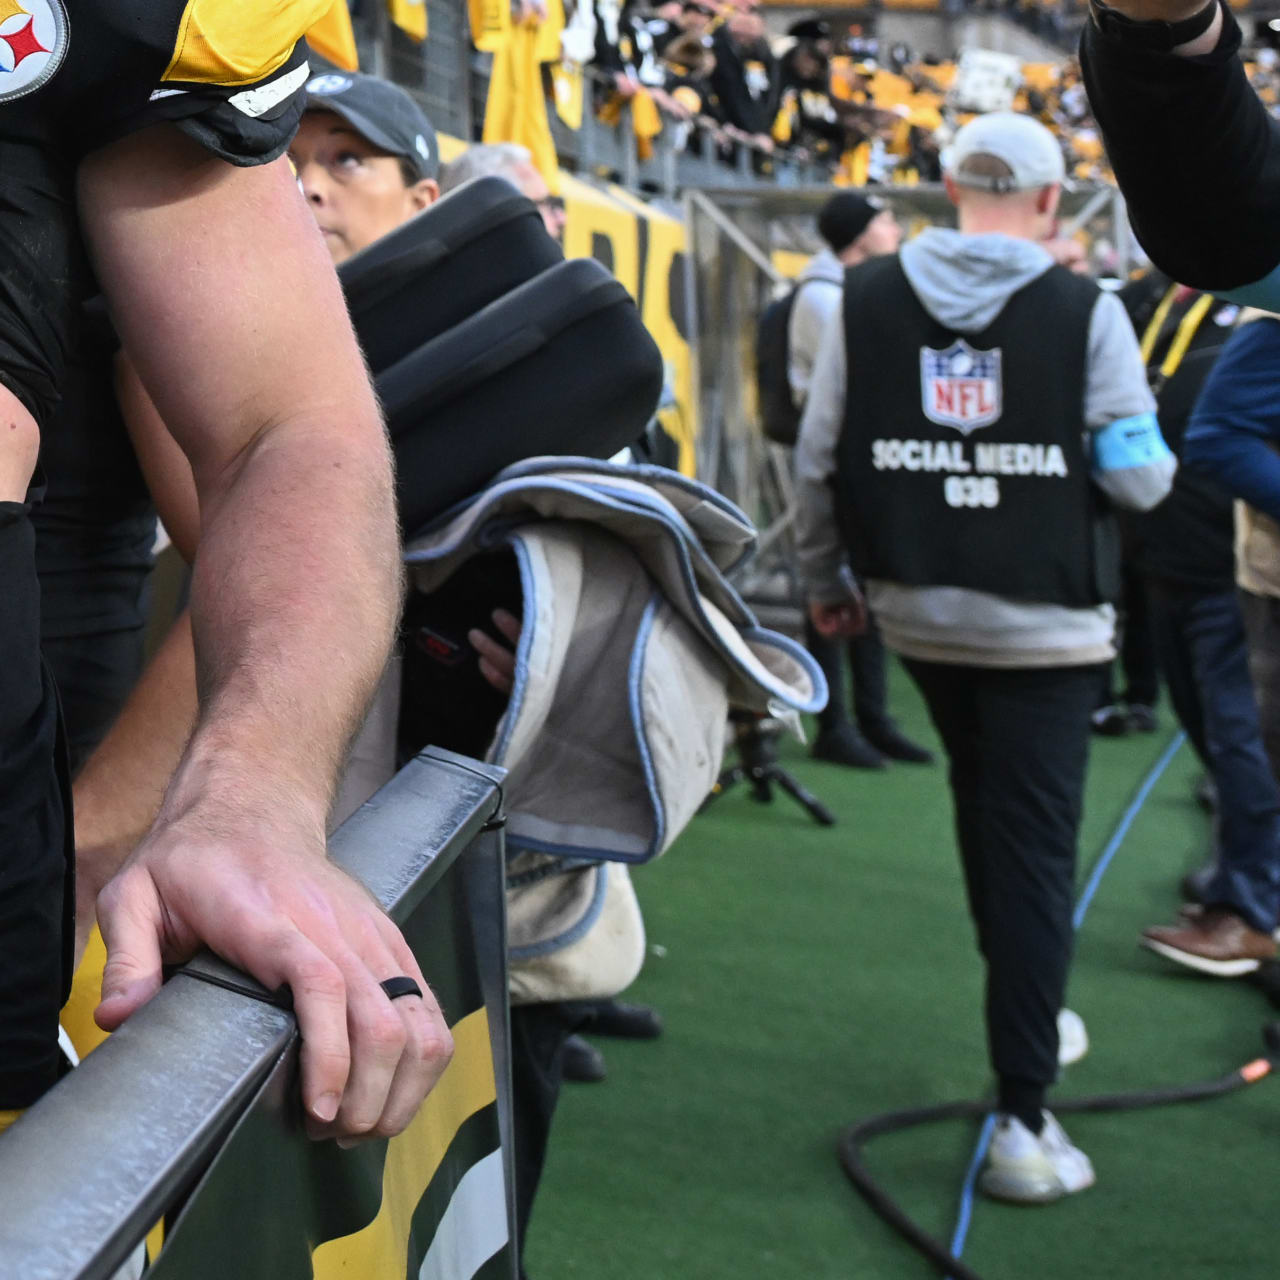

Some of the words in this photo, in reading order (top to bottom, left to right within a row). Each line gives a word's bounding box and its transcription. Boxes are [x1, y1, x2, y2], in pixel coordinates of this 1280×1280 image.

[933, 379, 996, 420] NFL
[871, 438, 971, 473] SOCIAL
[974, 442, 1069, 478] MEDIA
